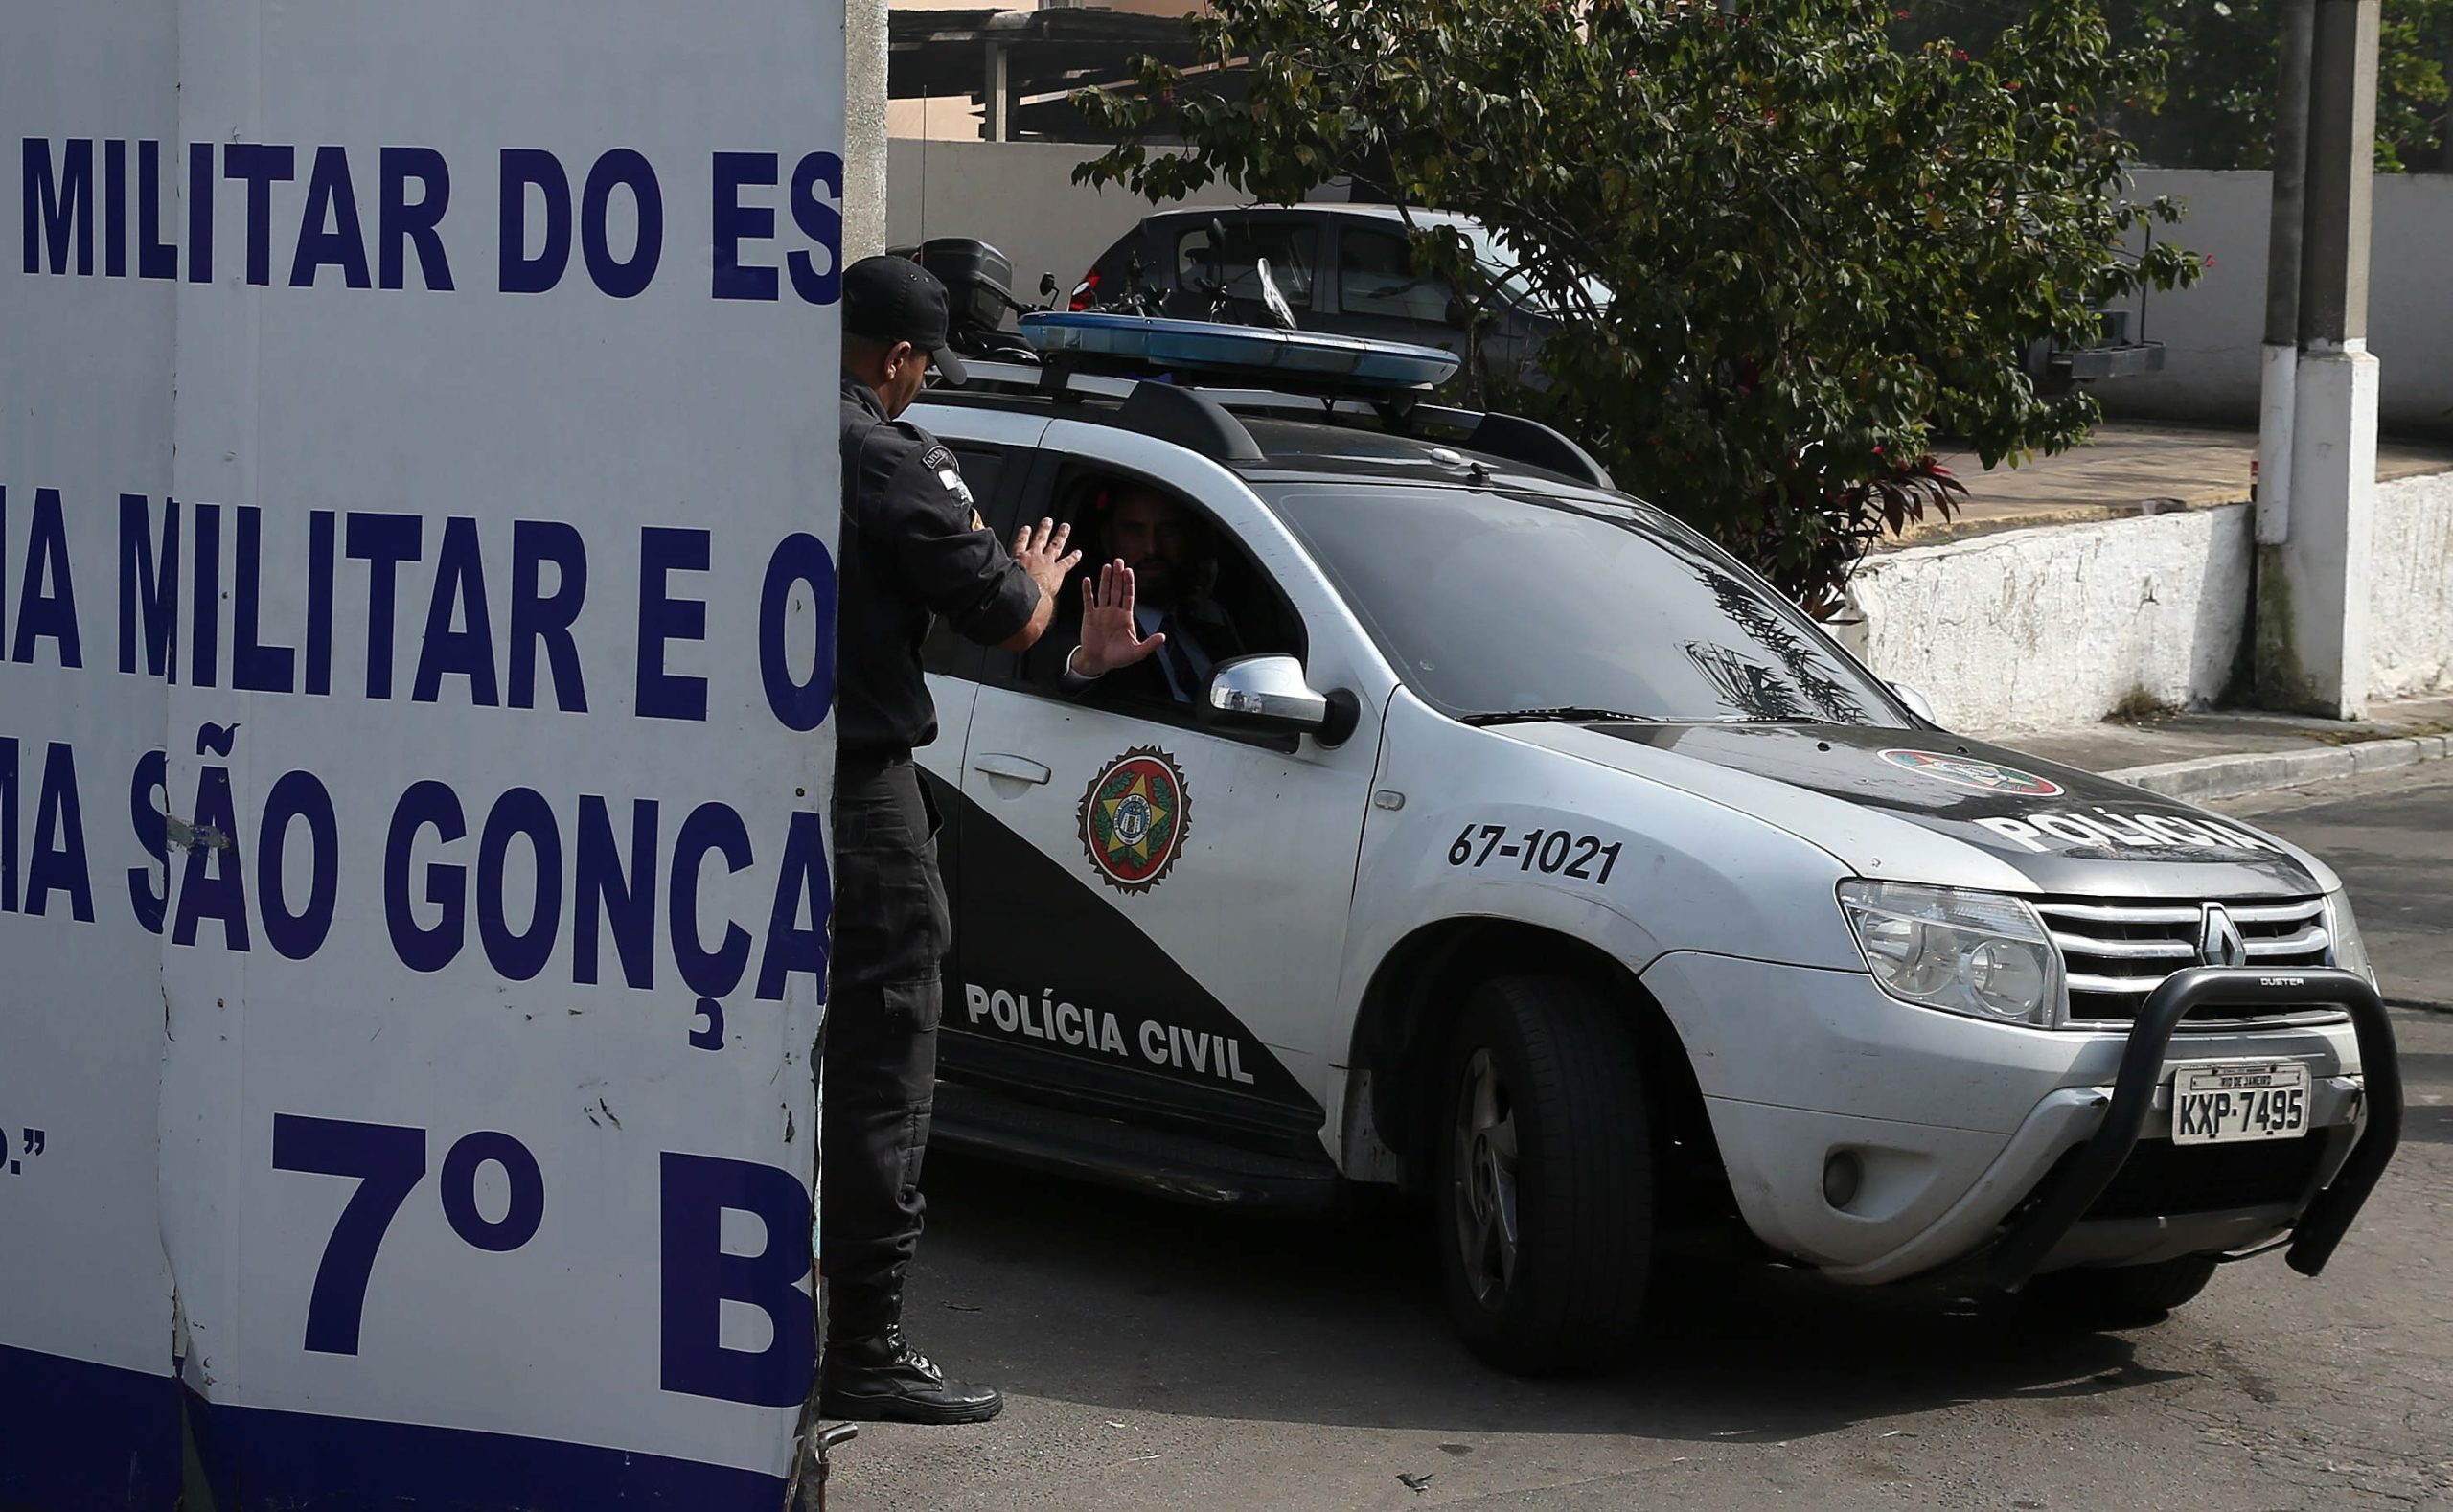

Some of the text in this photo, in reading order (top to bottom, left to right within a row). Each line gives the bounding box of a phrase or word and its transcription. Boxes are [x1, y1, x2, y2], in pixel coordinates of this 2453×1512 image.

[22, 137, 843, 306] MILITAR DO ES
[0, 475, 837, 733] A MILITAR E O
[1448, 823, 1623, 886] 67-1021
[1973, 806, 2285, 853] POLÍCIA
[127, 722, 339, 960] SÃO
[383, 779, 834, 1052] GONÇA
[2259, 977, 2304, 986] DUSTER
[965, 983, 1255, 1086] POLÍCIA CIVIL
[2179, 1089, 2304, 1135] KXP-7495
[2234, 1076, 2242, 1087] DE
[659, 1150, 817, 1409] B
